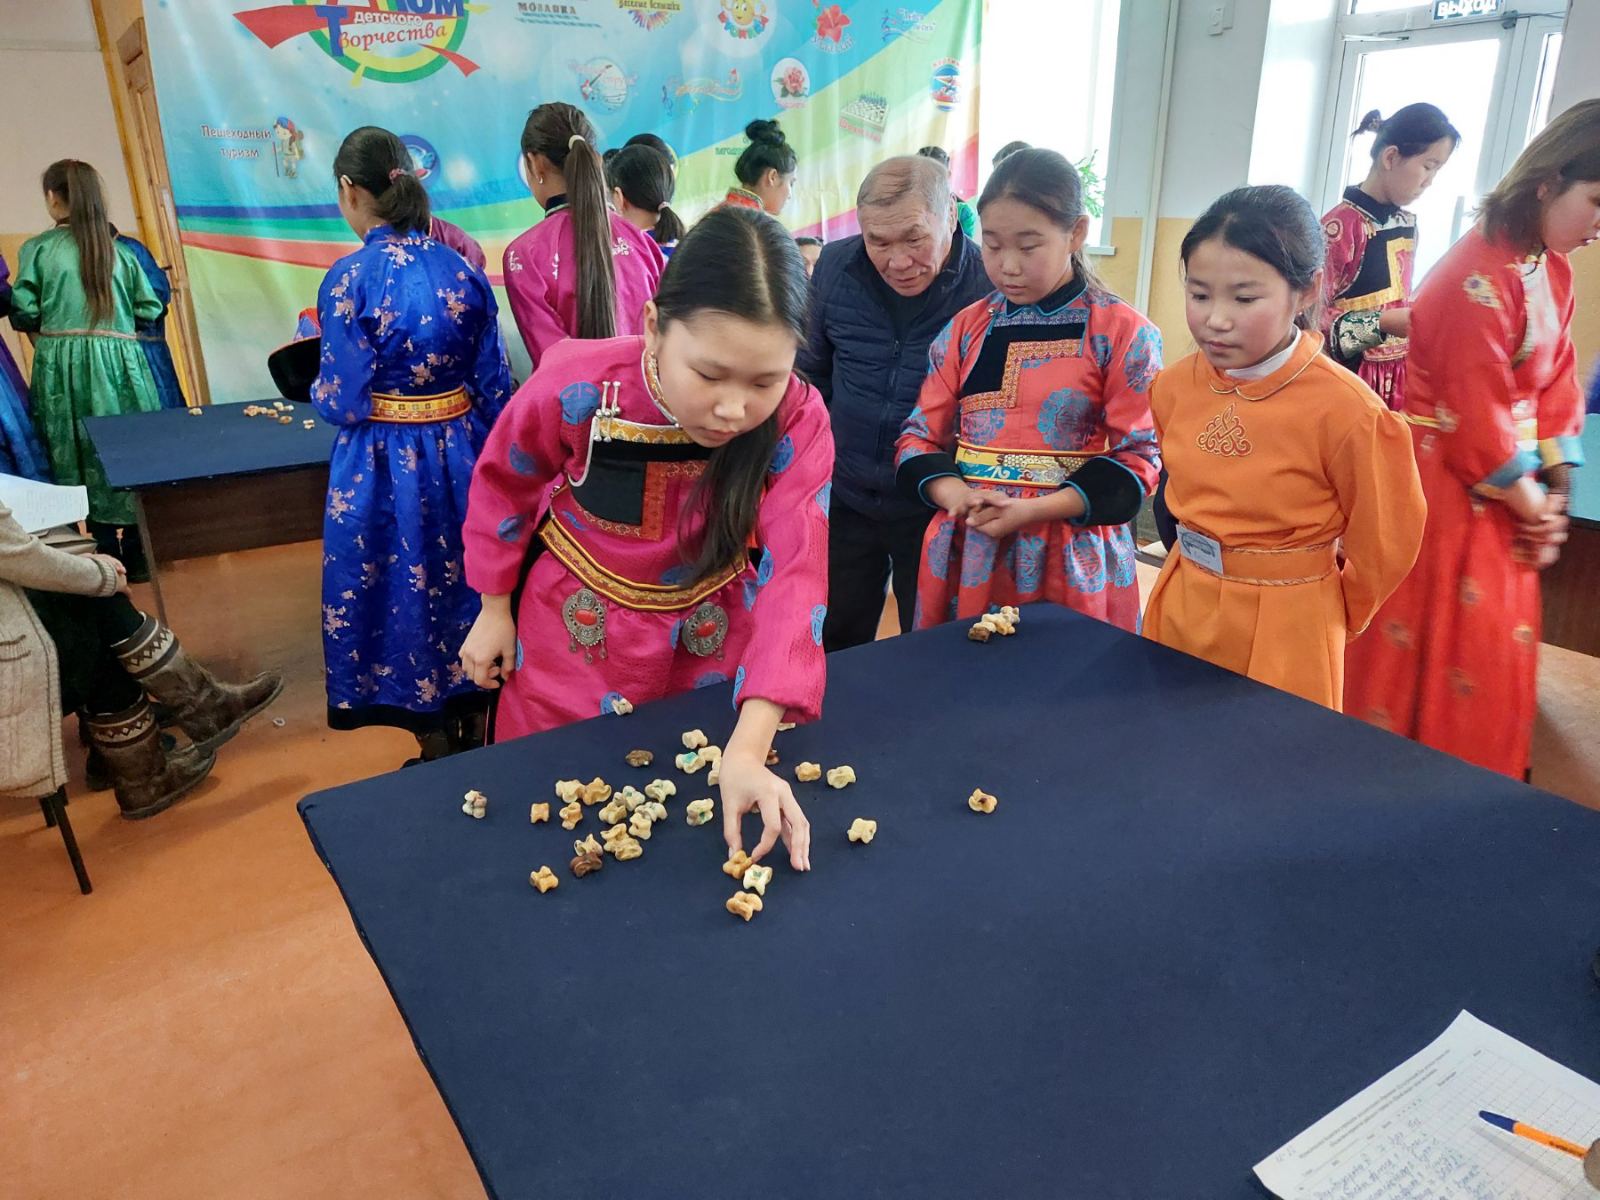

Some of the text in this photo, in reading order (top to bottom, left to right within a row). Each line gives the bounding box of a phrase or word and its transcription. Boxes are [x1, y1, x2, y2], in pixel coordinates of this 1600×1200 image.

[353, 11, 423, 26] детского
[314, 5, 447, 57] Творчества
[201, 124, 272, 139] Пешеходный
